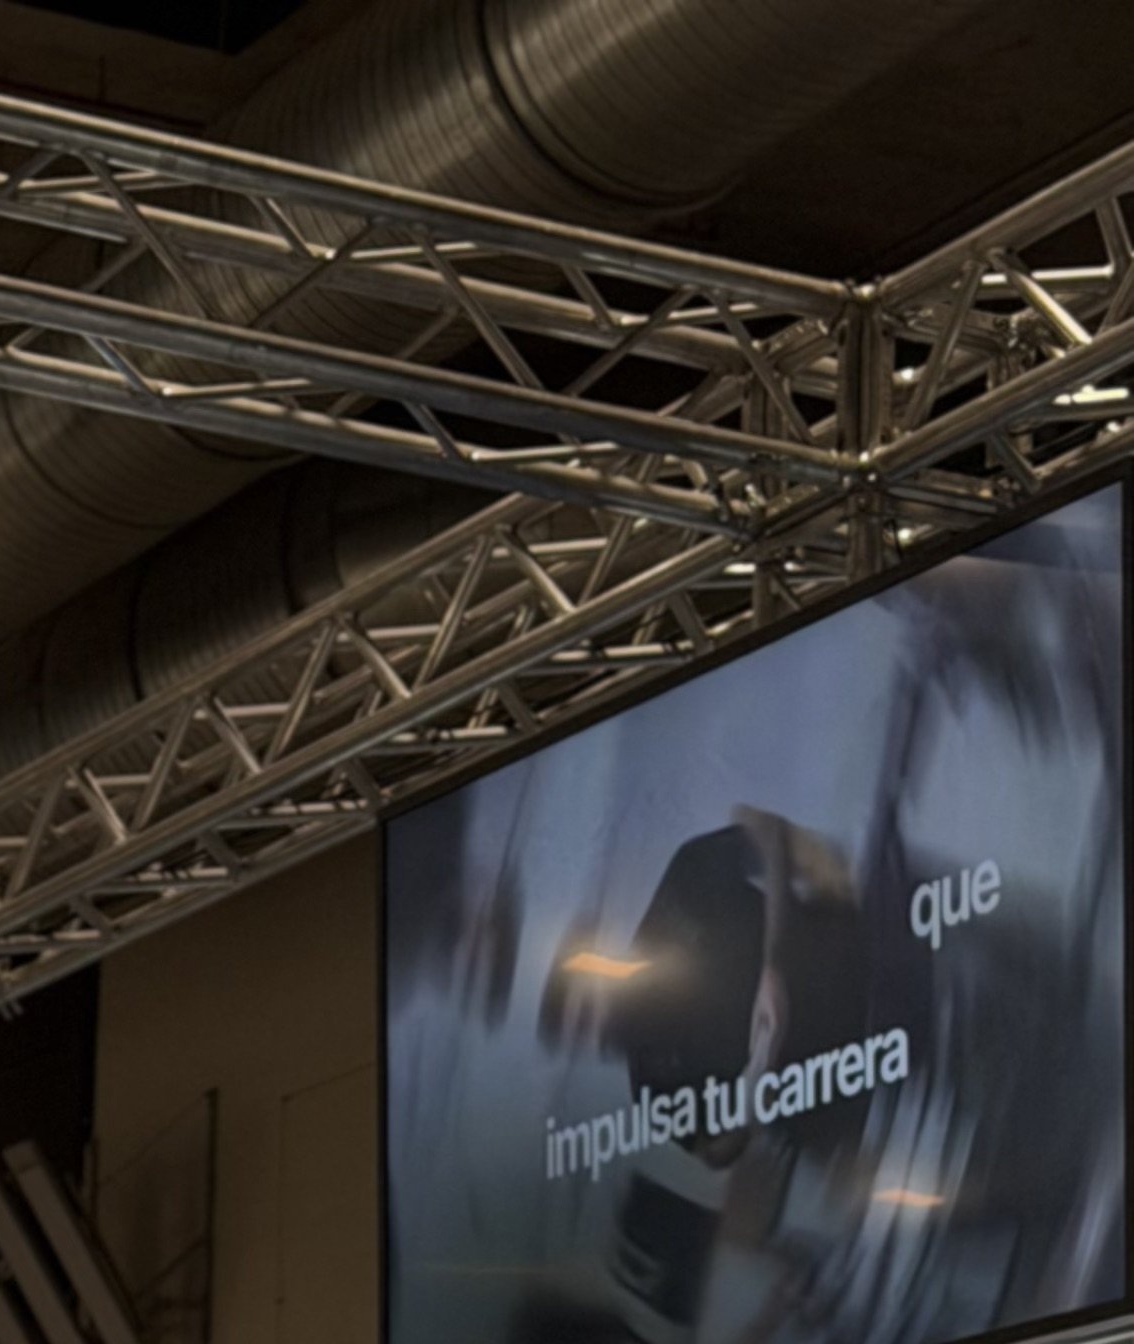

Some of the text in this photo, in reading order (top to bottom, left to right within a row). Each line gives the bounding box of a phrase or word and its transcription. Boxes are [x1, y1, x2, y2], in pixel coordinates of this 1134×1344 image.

[910, 859, 1002, 950] que
[545, 1027, 910, 1182] impulsa tu carrera
